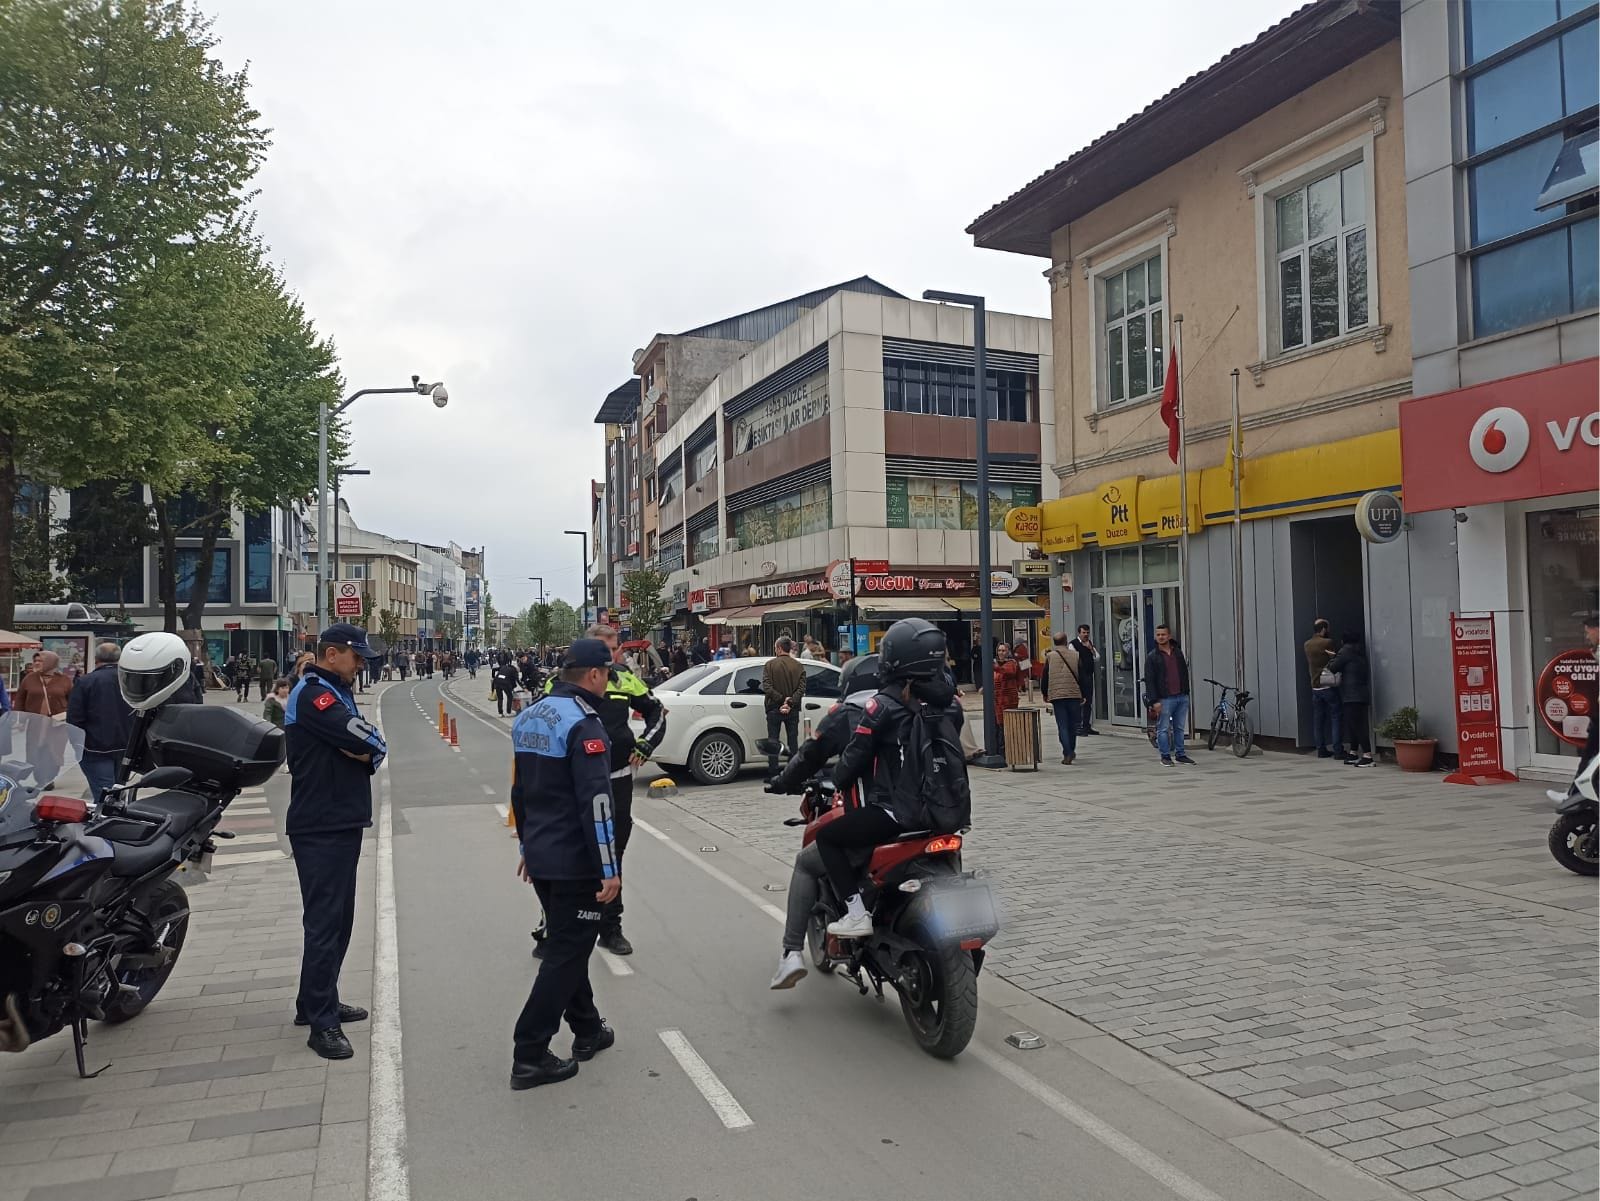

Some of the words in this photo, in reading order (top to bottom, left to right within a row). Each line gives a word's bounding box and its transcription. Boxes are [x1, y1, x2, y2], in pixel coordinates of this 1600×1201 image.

[1111, 504, 1129, 524] Ptt
[1370, 508, 1399, 521] UPT
[865, 576, 914, 591] OLGUN
[1554, 665, 1573, 675] ÇOK
[1469, 731, 1495, 739] vodafone
[577, 909, 602, 921] ZABITA
